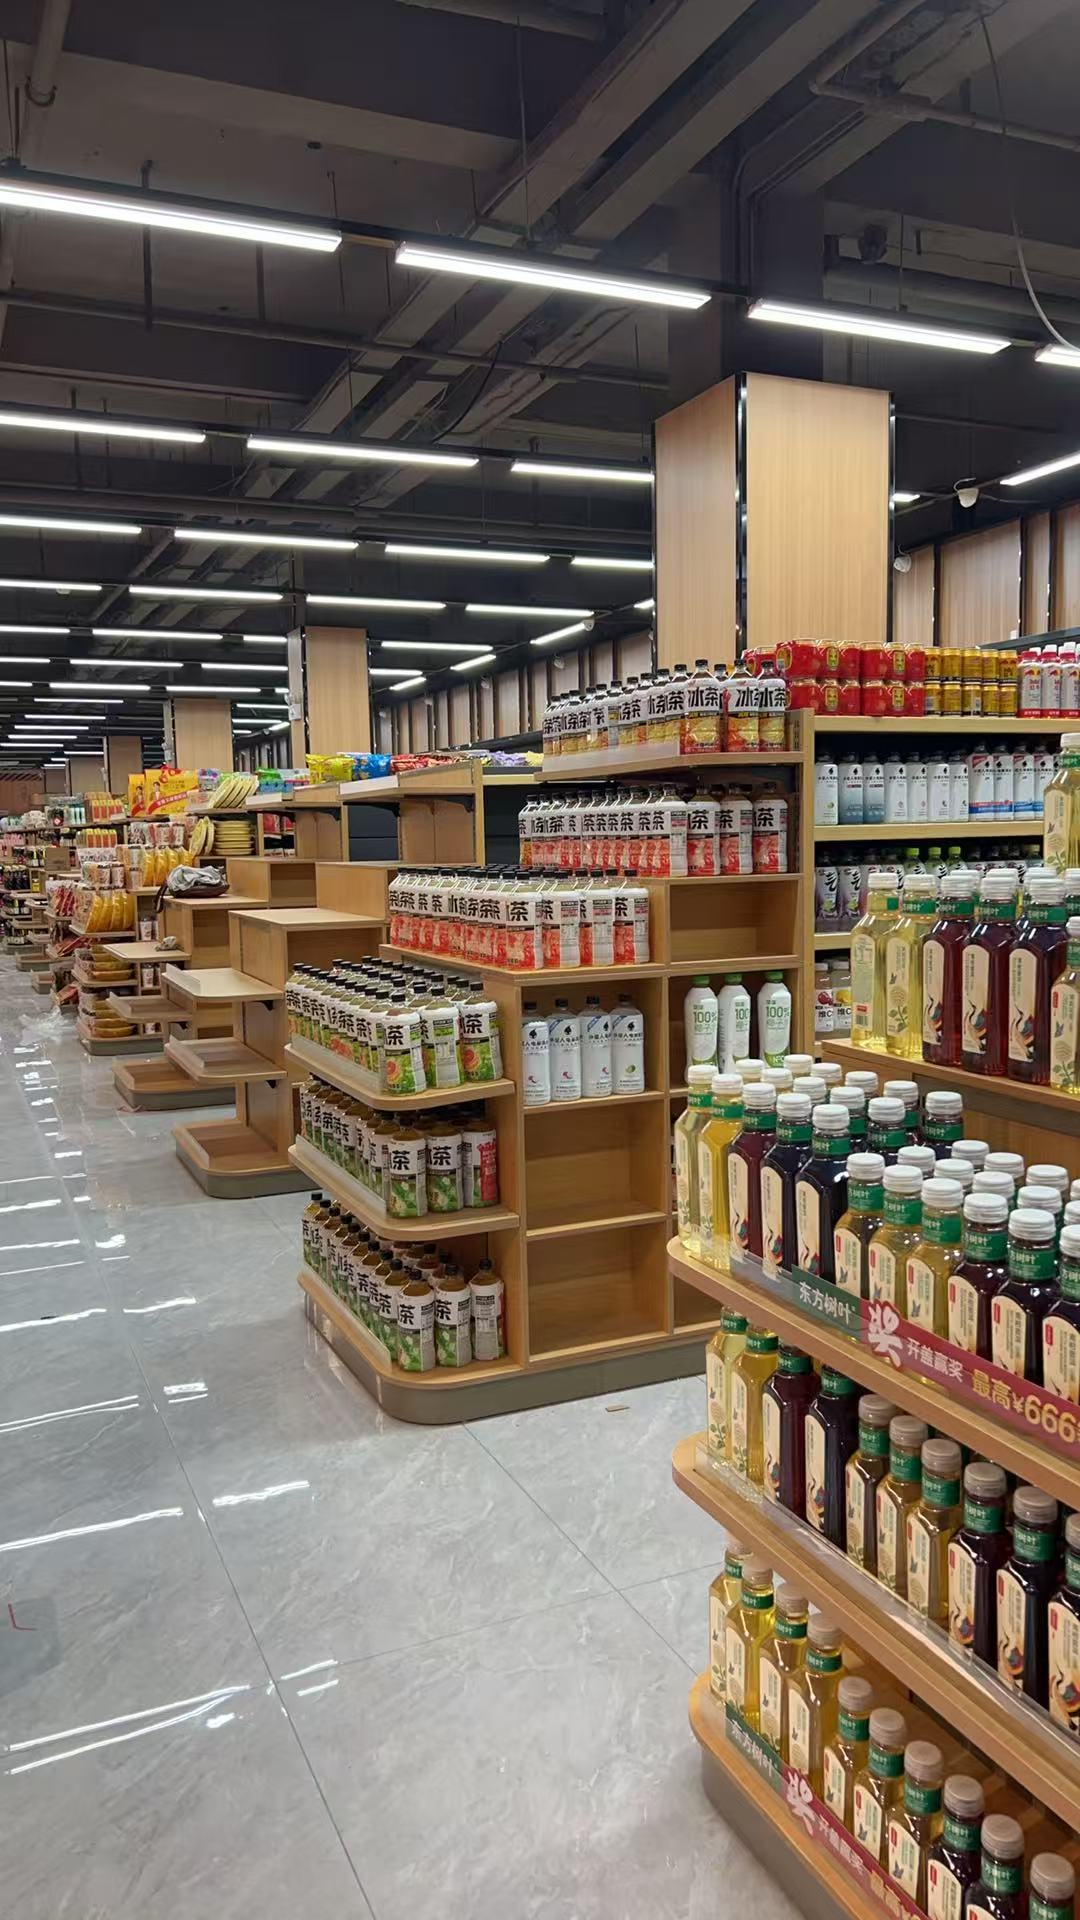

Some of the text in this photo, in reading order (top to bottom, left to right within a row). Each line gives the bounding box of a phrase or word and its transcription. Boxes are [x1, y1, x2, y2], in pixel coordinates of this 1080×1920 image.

[665, 690, 684, 711] 茶
[688, 687, 718, 707] 冰茶
[688, 809, 709, 829] 茶
[754, 808, 774, 827] 茶
[506, 901, 529, 921] 茶
[462, 1014, 483, 1034] 茶
[384, 1025, 403, 1046] 茶
[392, 1150, 410, 1170] 茶
[429, 1146, 452, 1166] 茶
[435, 1299, 452, 1321] 茶
[799, 1281, 851, 1325] 东方树叶
[400, 1303, 415, 1325] 茶
[907, 1337, 963, 1383] 开盖赢奖
